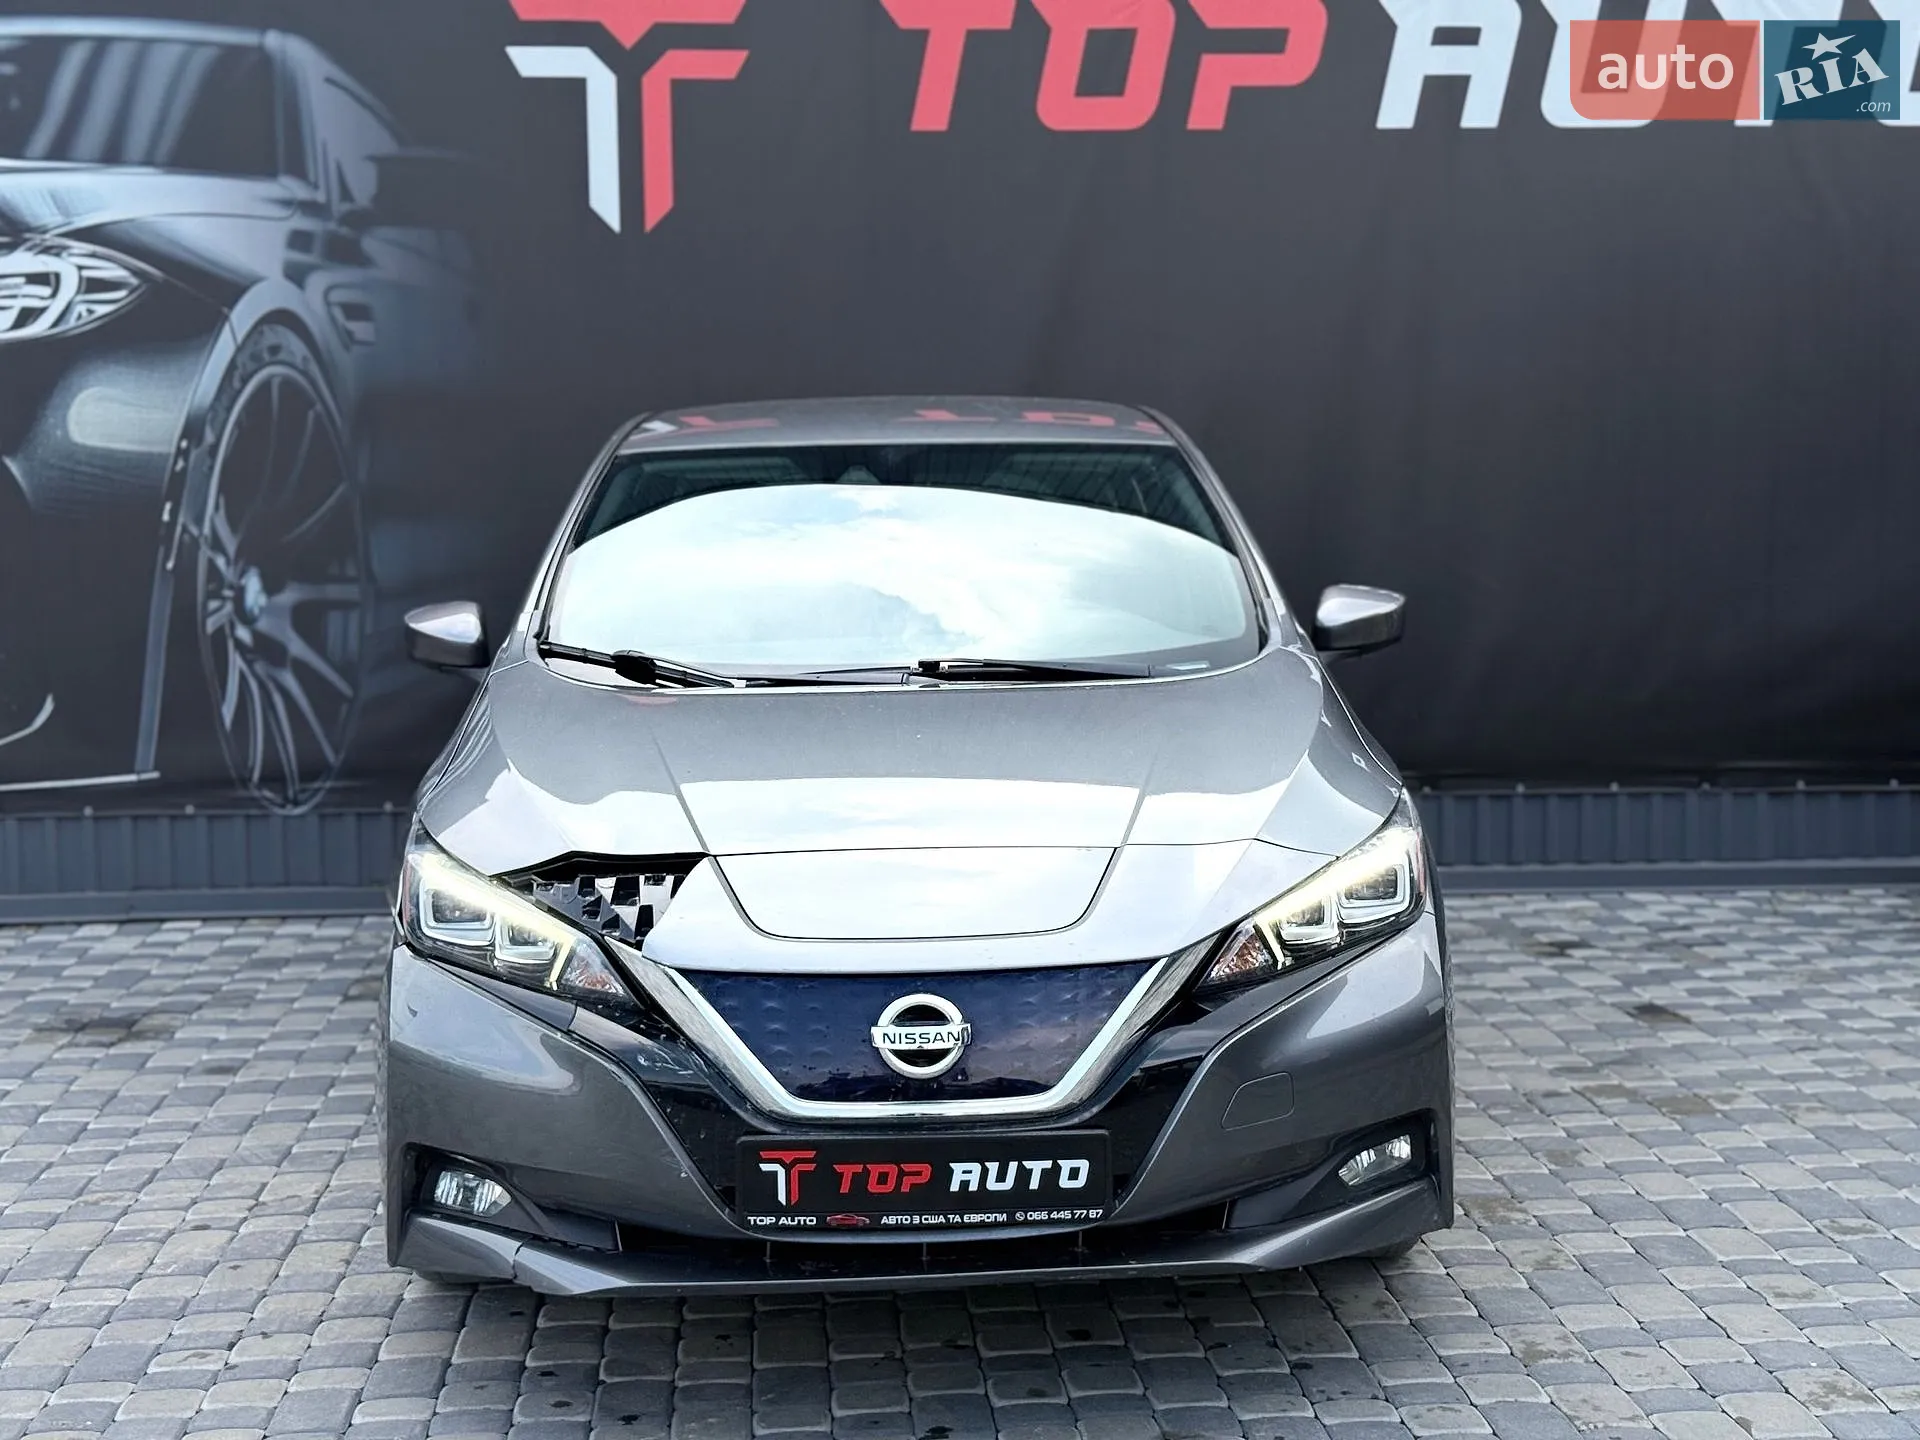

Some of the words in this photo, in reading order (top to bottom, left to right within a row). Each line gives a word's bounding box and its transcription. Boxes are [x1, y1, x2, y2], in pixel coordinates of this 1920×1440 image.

[880, 0, 1328, 131] TOP
[882, 1031, 960, 1045] NISSAN
[832, 1163, 932, 1194] TOP
[949, 1159, 1090, 1192] AUTO
[747, 1216, 776, 1225] TOP
[778, 1216, 817, 1225] AUTO
[880, 1215, 911, 1225] АВТО
[921, 1214, 946, 1224] США
[948, 1214, 962, 1223] ТА
[963, 1213, 1007, 1223] ЄВРОПИ
[1050, 1210, 1072, 1219] 445
[1073, 1210, 1088, 1218] 77
[1089, 1209, 1103, 1218] 87
